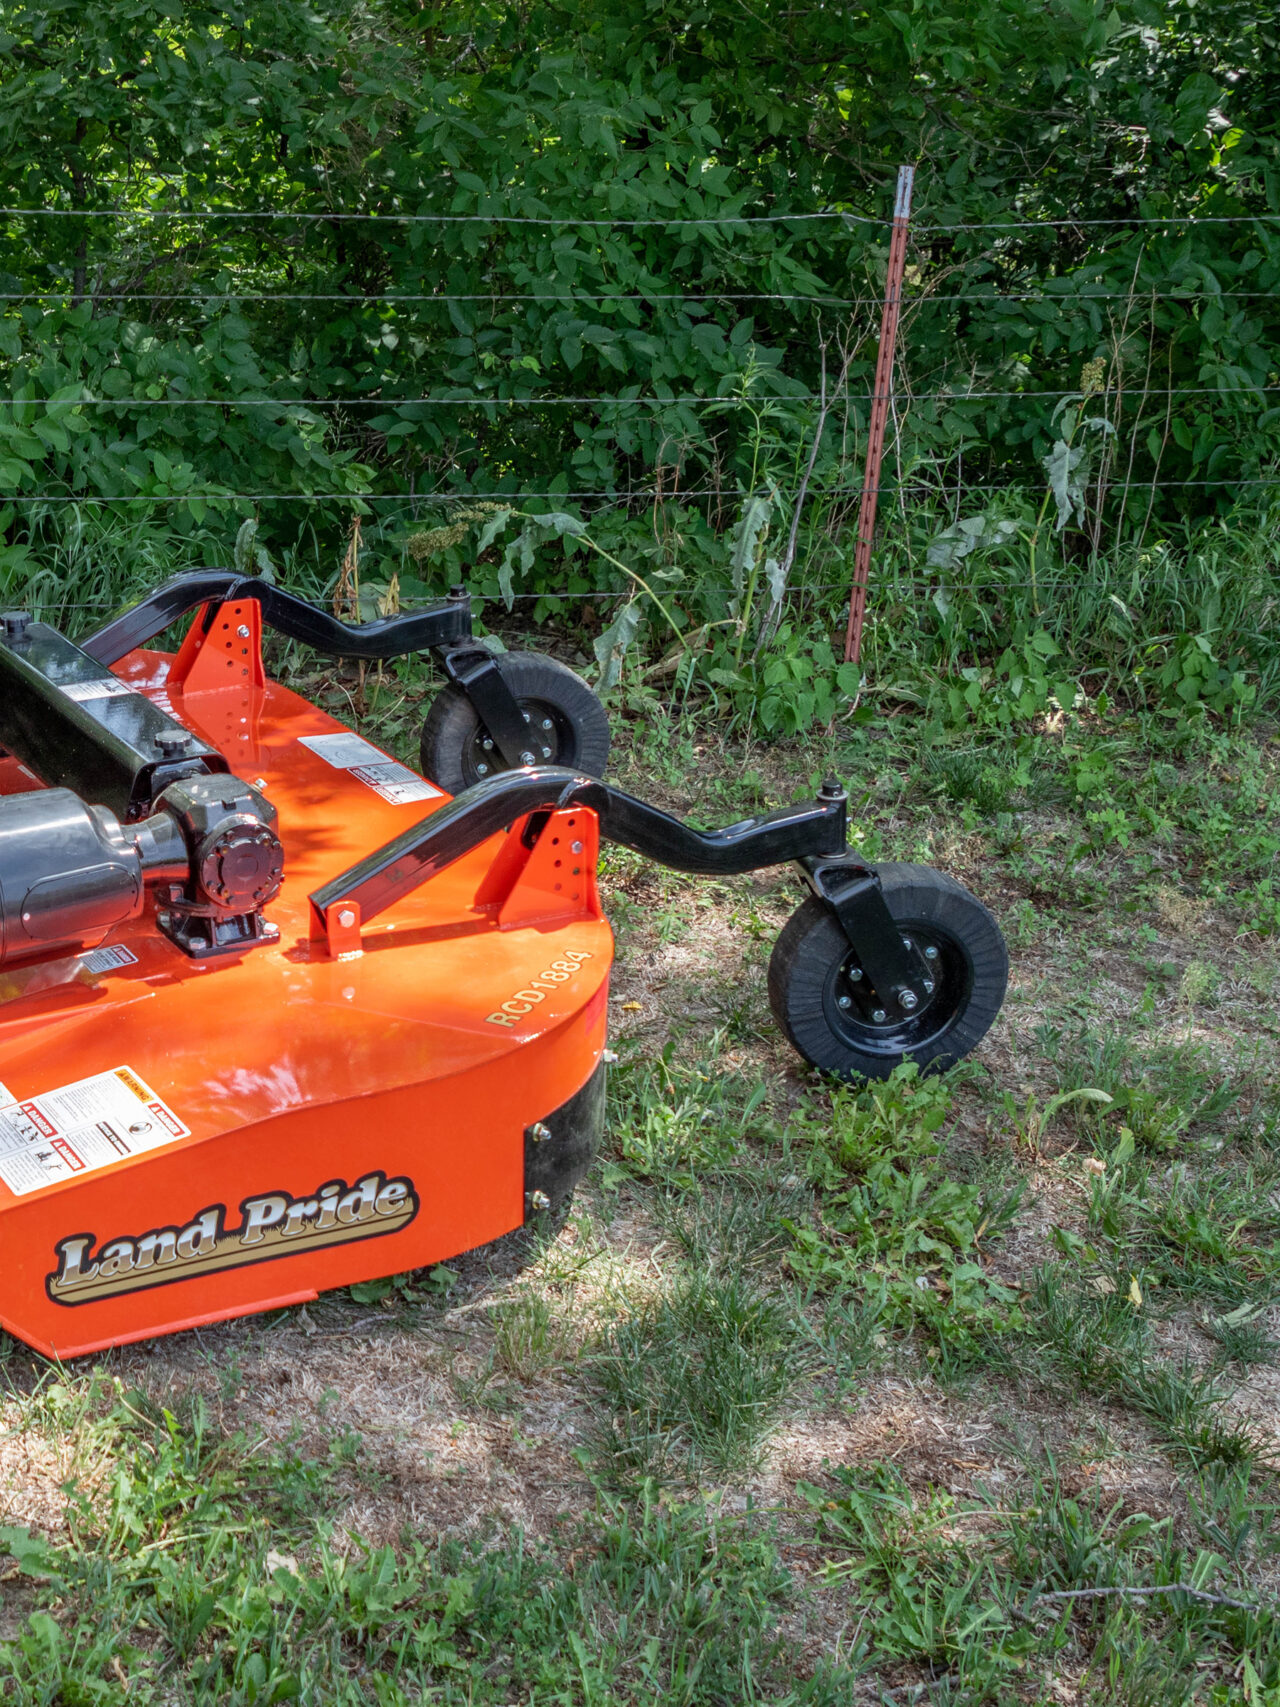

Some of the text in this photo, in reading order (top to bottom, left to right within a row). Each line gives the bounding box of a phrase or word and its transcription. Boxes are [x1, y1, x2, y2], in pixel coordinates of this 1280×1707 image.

[485, 951, 592, 1028] RCD1884
[122, 1074, 150, 1100] WARNING
[28, 1110, 53, 1136] DANGER
[156, 1109, 182, 1134] DANGER
[57, 1145, 82, 1169] DANGER
[55, 1175, 409, 1288] Land Pride
